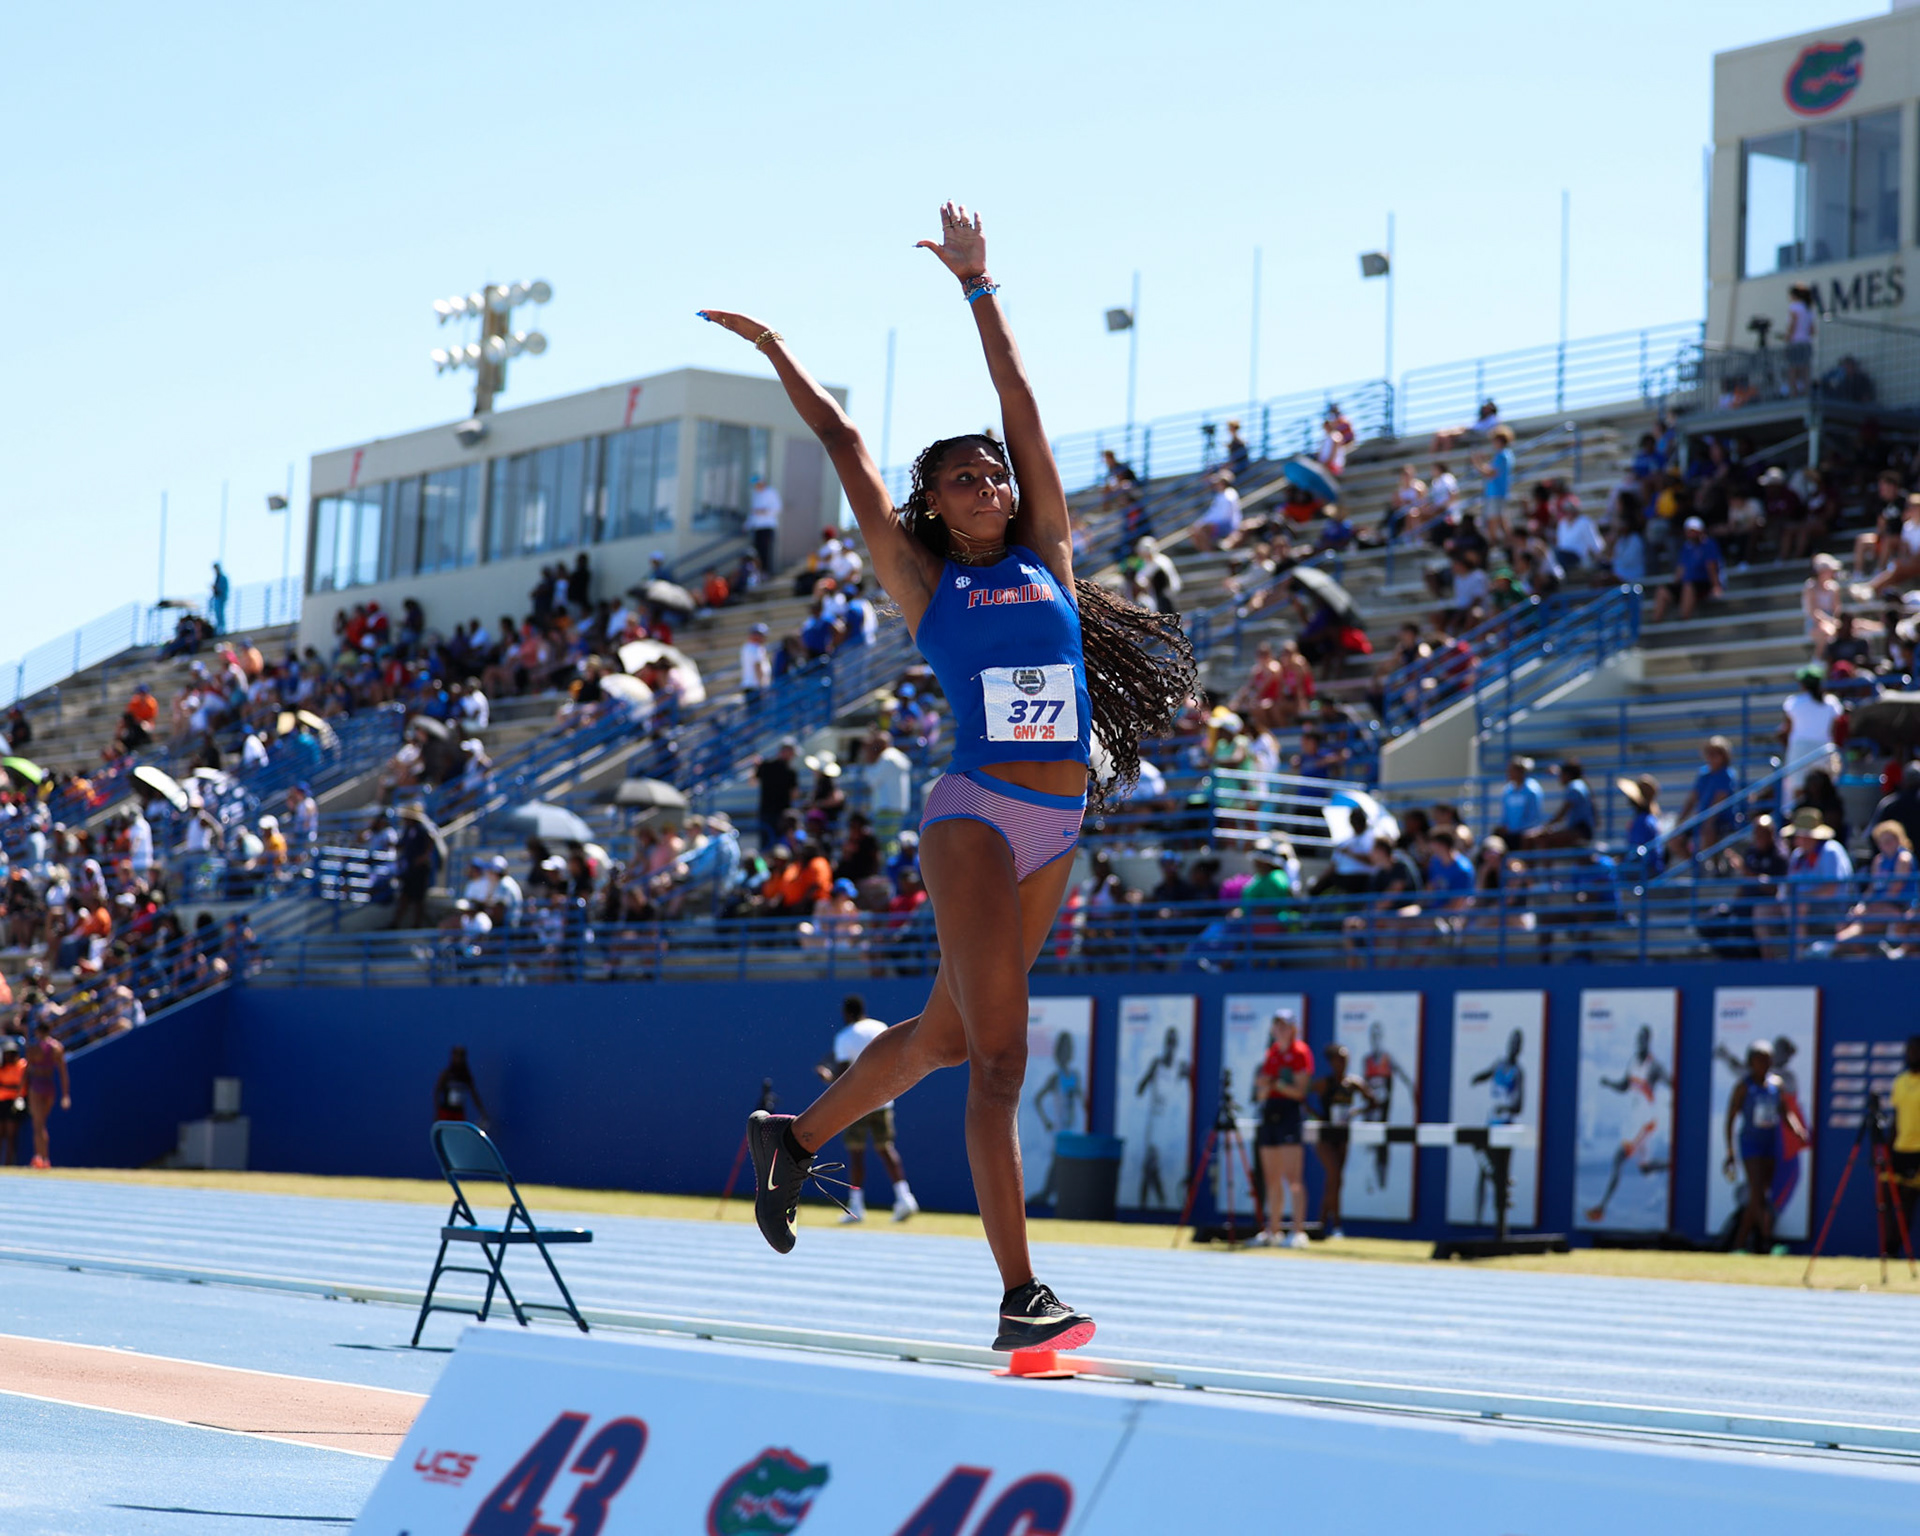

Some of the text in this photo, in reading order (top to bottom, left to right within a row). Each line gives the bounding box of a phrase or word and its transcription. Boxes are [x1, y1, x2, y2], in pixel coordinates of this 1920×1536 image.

[955, 575, 972, 589] SEC
[967, 583, 1054, 609] FLORIDA
[1007, 700, 1065, 723] 377
[1013, 725, 1055, 740] GNV '25
[414, 1447, 478, 1478] UCS
[463, 1410, 648, 1536] 43
